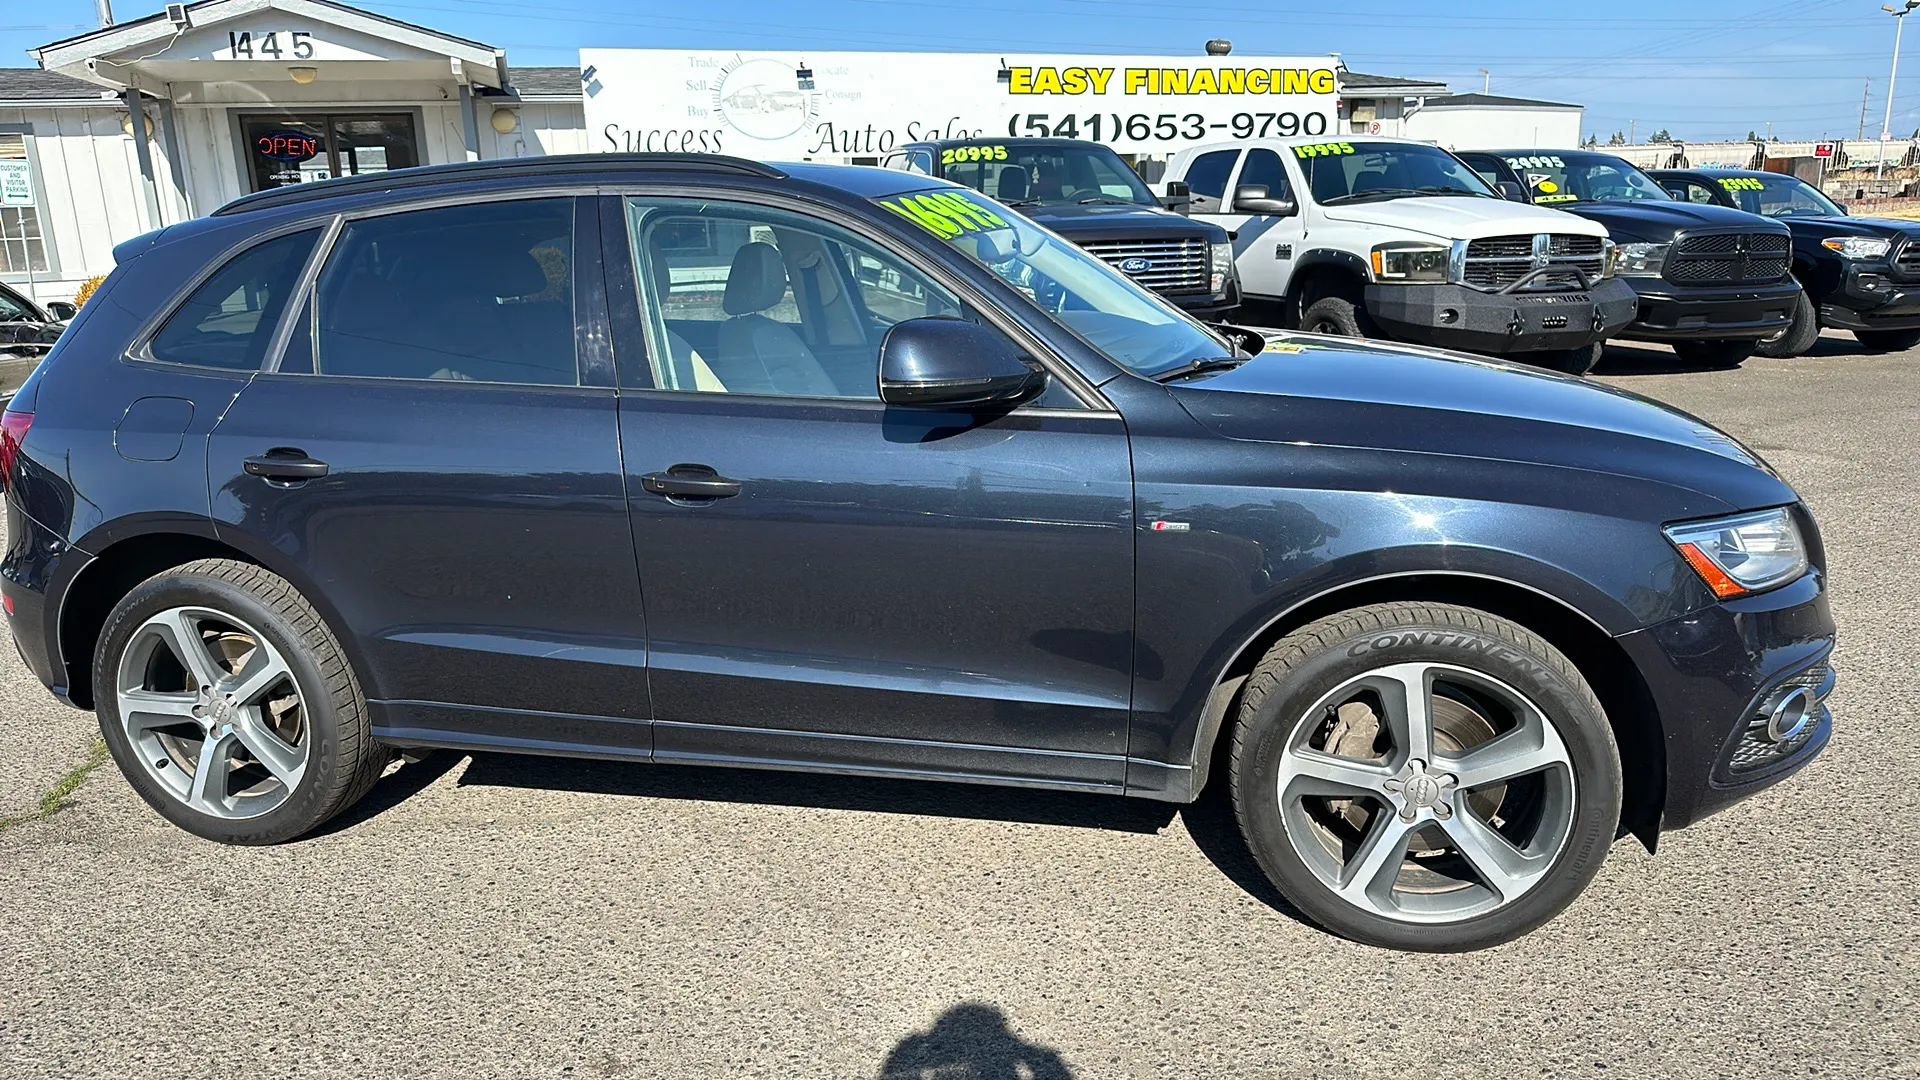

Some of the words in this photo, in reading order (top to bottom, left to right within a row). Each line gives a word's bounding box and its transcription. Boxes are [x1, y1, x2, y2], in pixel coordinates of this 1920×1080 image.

[229, 31, 314, 60] 1445
[688, 56, 720, 69] Trade
[686, 79, 707, 92] Sell
[1009, 66, 1115, 95] EASY
[1125, 68, 1335, 96] FINANCING
[687, 105, 709, 119] Buy
[259, 137, 316, 156] OPEN
[602, 123, 723, 154] Success
[808, 122, 895, 154] Auto
[942, 146, 1008, 164] 20995
[1294, 142, 1355, 159] 19995
[1717, 177, 1765, 191] 23995
[879, 191, 1010, 241] 16995
[1126, 260, 1147, 270] Ford
